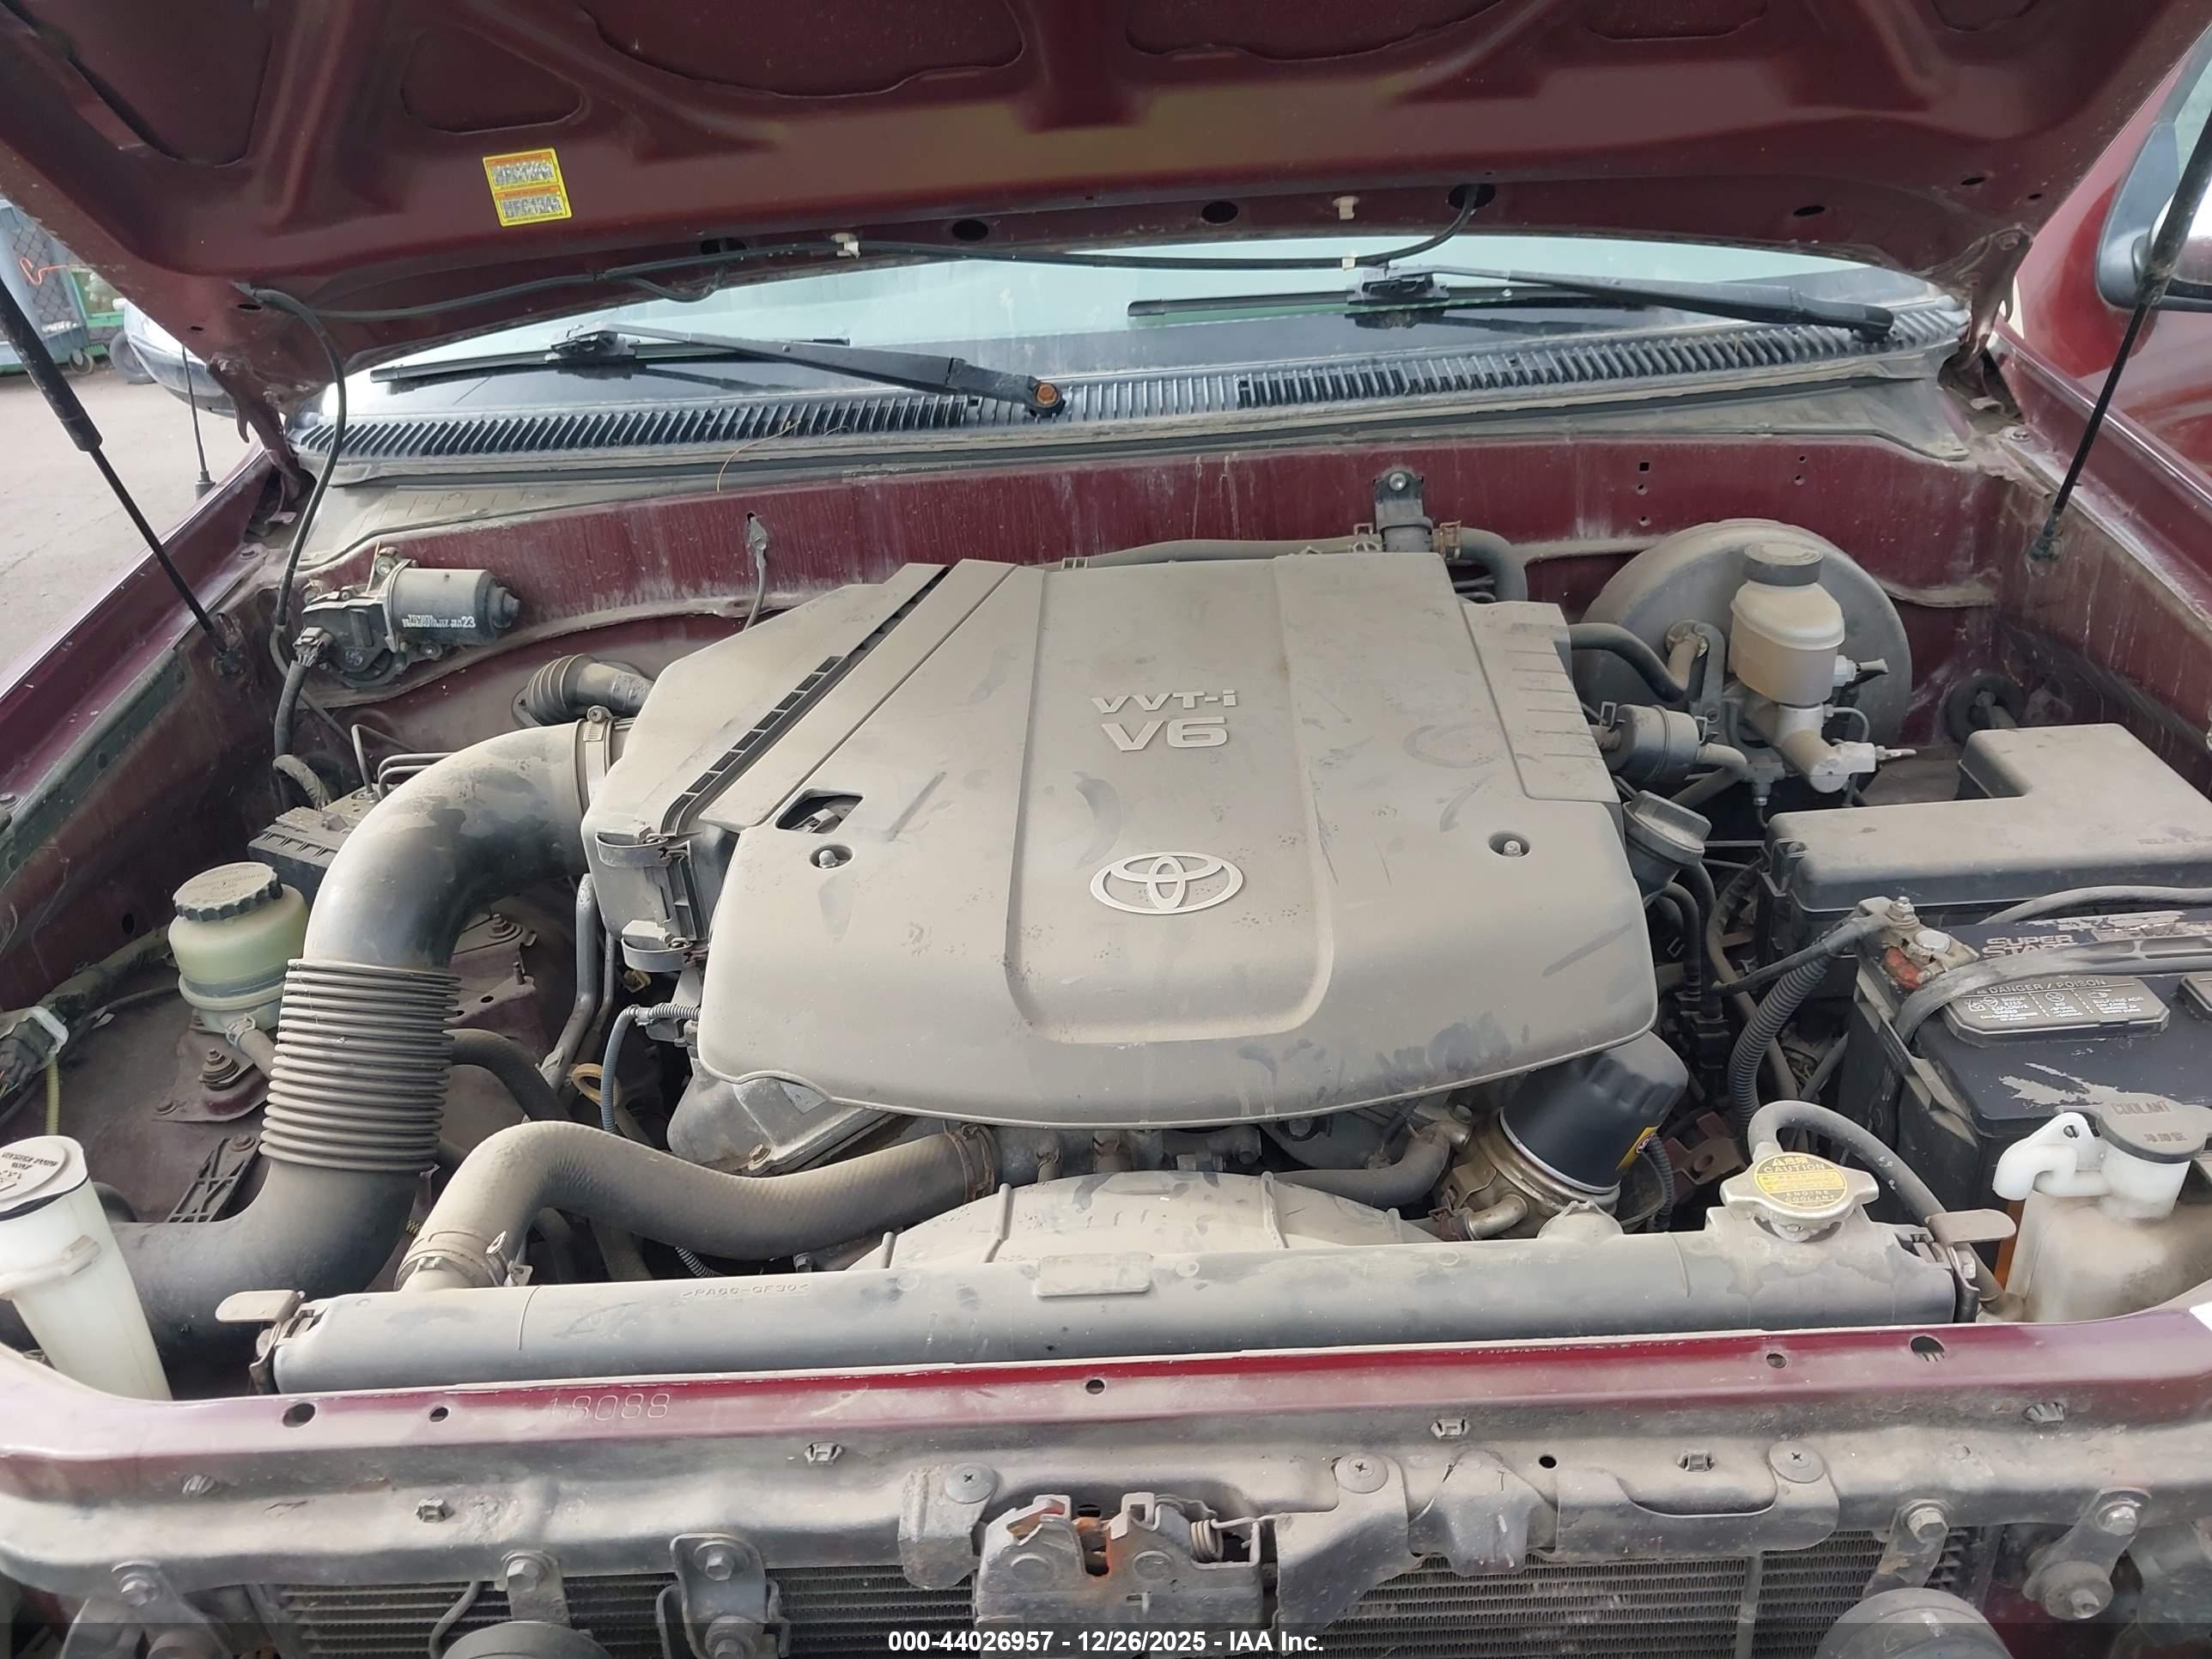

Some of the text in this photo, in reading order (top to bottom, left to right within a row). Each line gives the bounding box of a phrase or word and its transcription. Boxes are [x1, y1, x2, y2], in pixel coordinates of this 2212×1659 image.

[1091, 689, 1237, 714] VVT-i
[1101, 716, 1228, 752] V6
[1985, 934, 2075, 946] SUPER
[1988, 982, 2044, 994] DANGER
[2055, 978, 2107, 989] POISON
[2110, 1100, 2172, 1115] COOLANT
[1764, 1163, 1826, 1174] CAUTION
